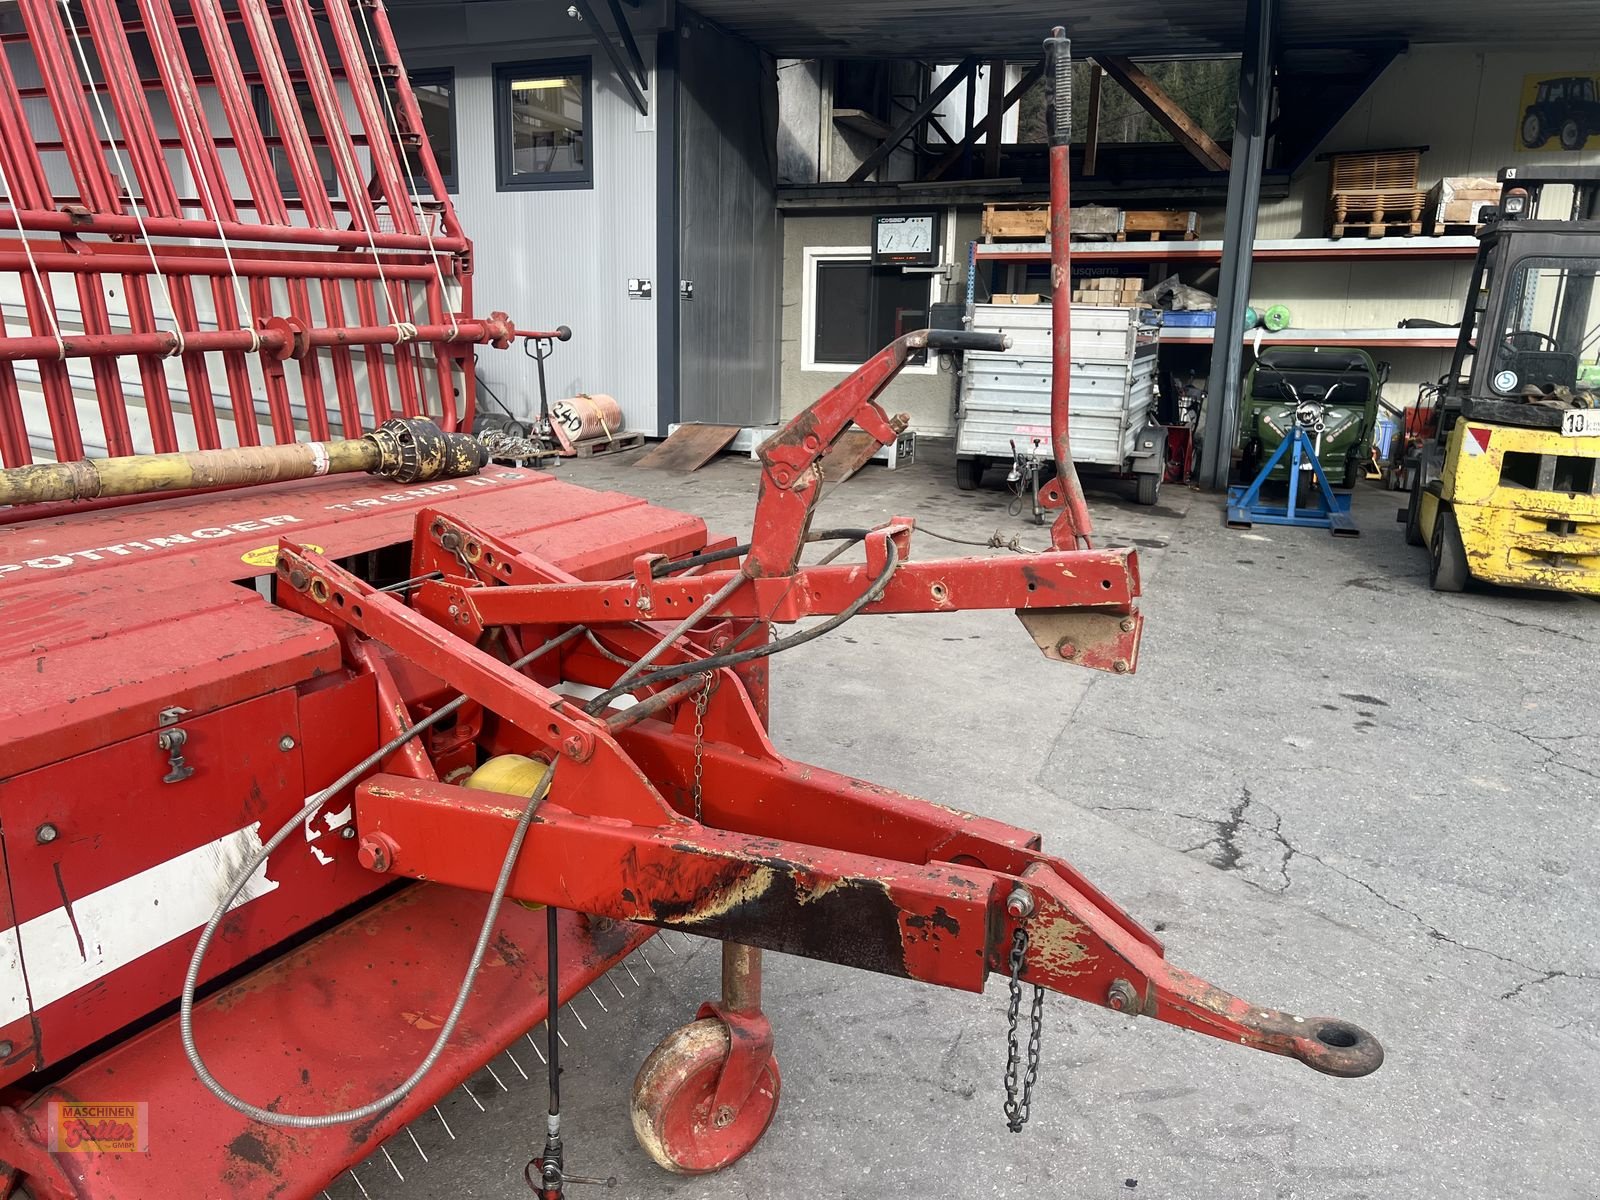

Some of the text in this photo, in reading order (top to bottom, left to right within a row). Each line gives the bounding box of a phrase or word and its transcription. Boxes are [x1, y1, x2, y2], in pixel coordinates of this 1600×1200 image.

[1072, 266, 1119, 276] usqvarna
[553, 402, 582, 431] 240
[1567, 414, 1584, 433] 10
[325, 484, 458, 511] TREND
